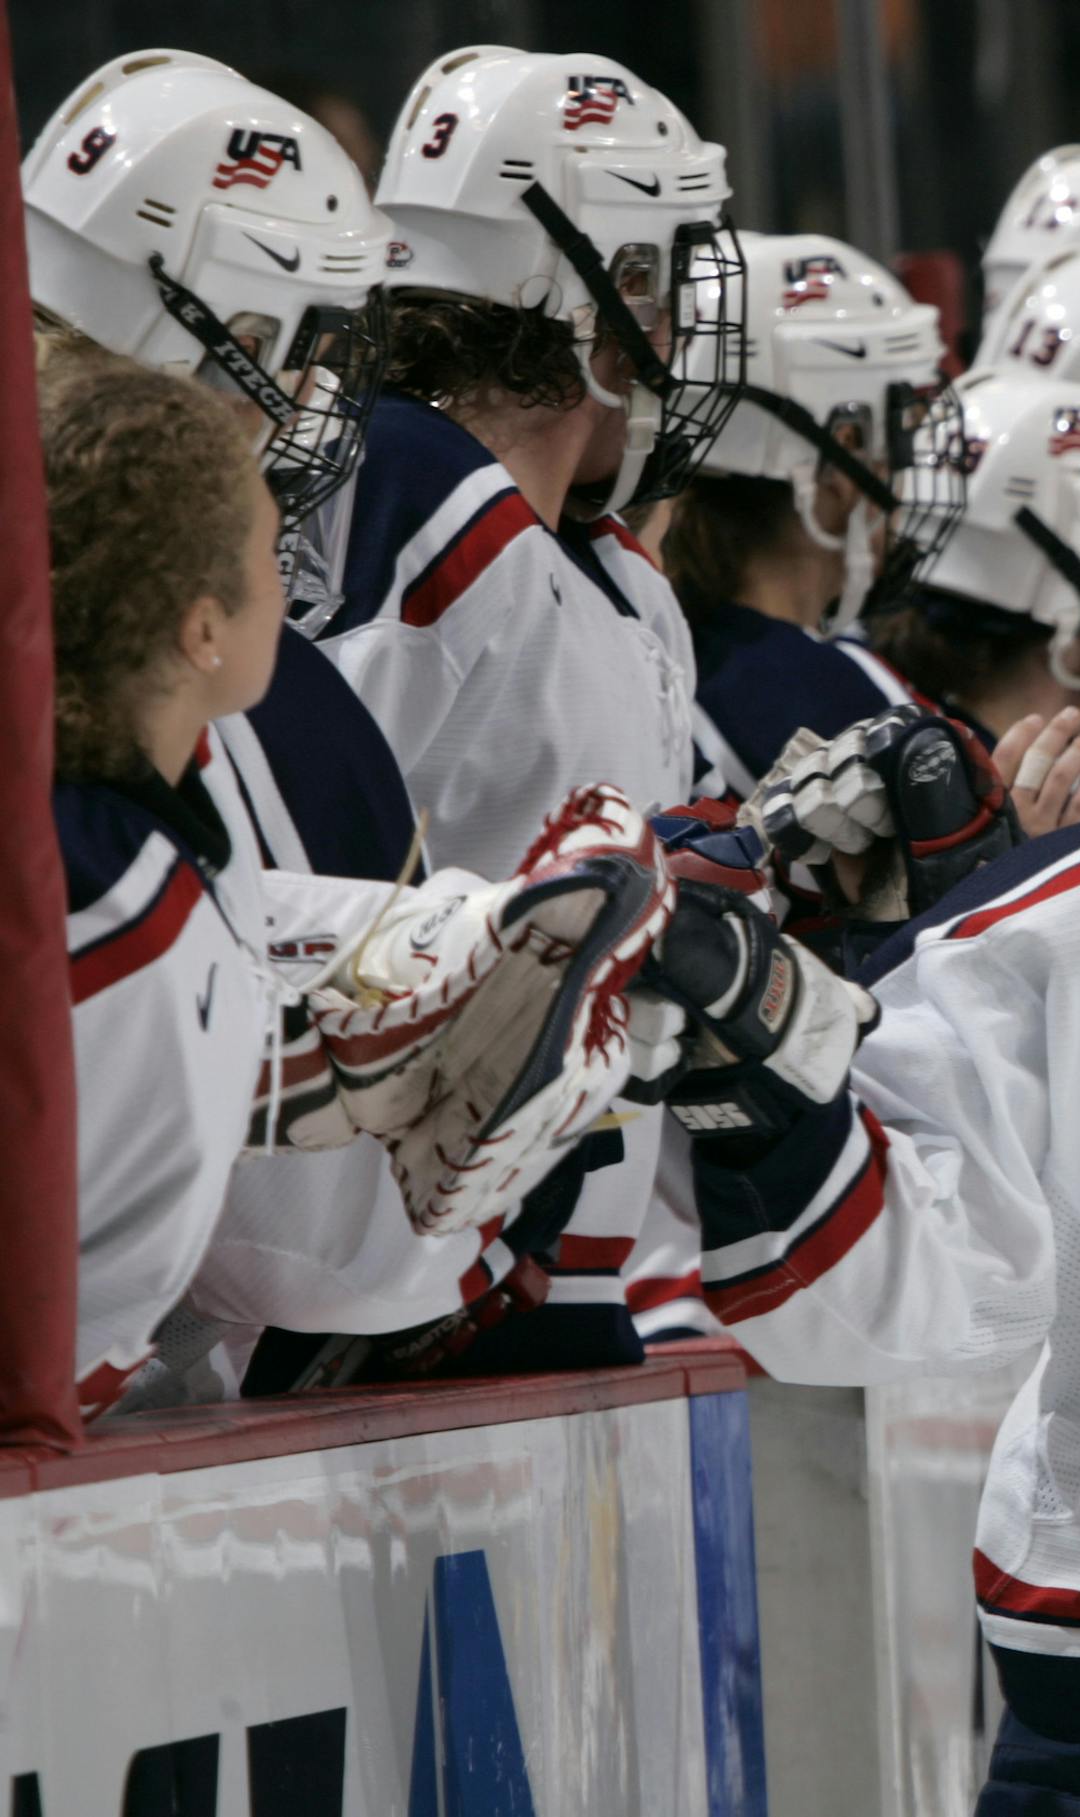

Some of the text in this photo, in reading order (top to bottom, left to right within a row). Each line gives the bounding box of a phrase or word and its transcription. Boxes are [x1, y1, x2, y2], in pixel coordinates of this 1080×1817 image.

[562, 74, 636, 132] USA
[67, 126, 117, 176] 9
[211, 127, 303, 191] USA
[420, 112, 459, 160] 3
[781, 256, 847, 311] USA
[1008, 318, 1067, 369] 13
